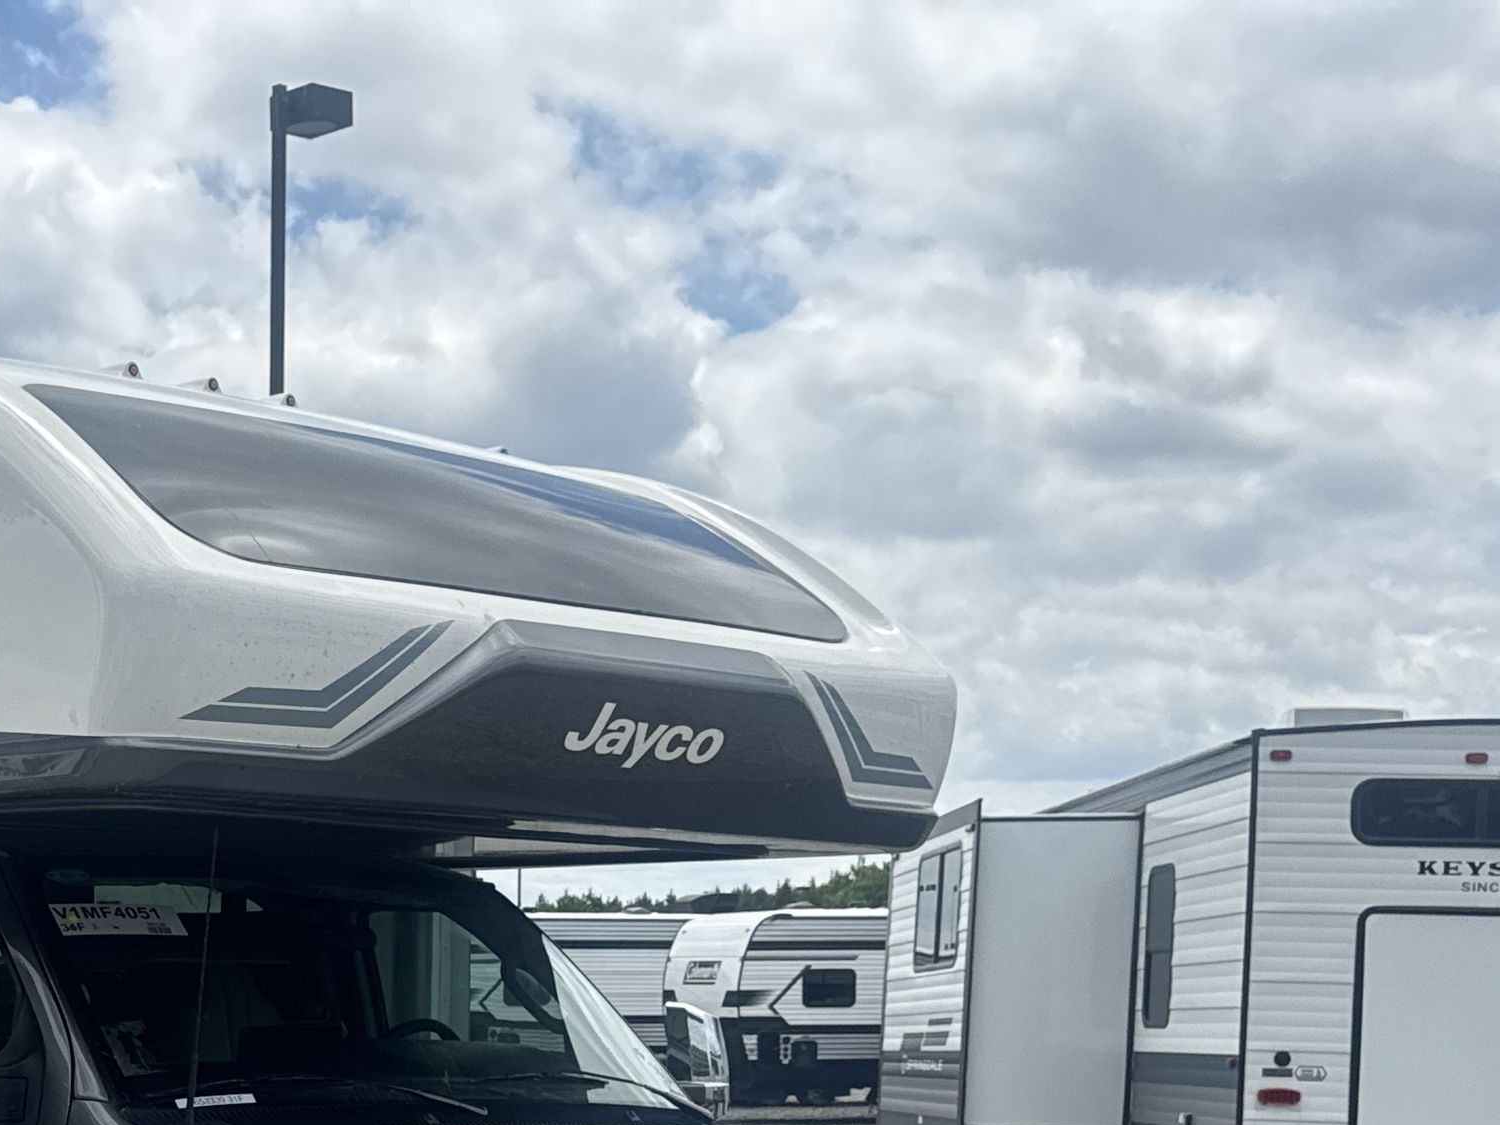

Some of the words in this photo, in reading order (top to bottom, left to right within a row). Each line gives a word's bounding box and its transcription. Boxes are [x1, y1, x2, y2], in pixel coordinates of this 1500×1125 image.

[564, 702, 725, 769] Jayco
[1418, 861, 1500, 876] KEYS
[1461, 882, 1499, 893] SINC
